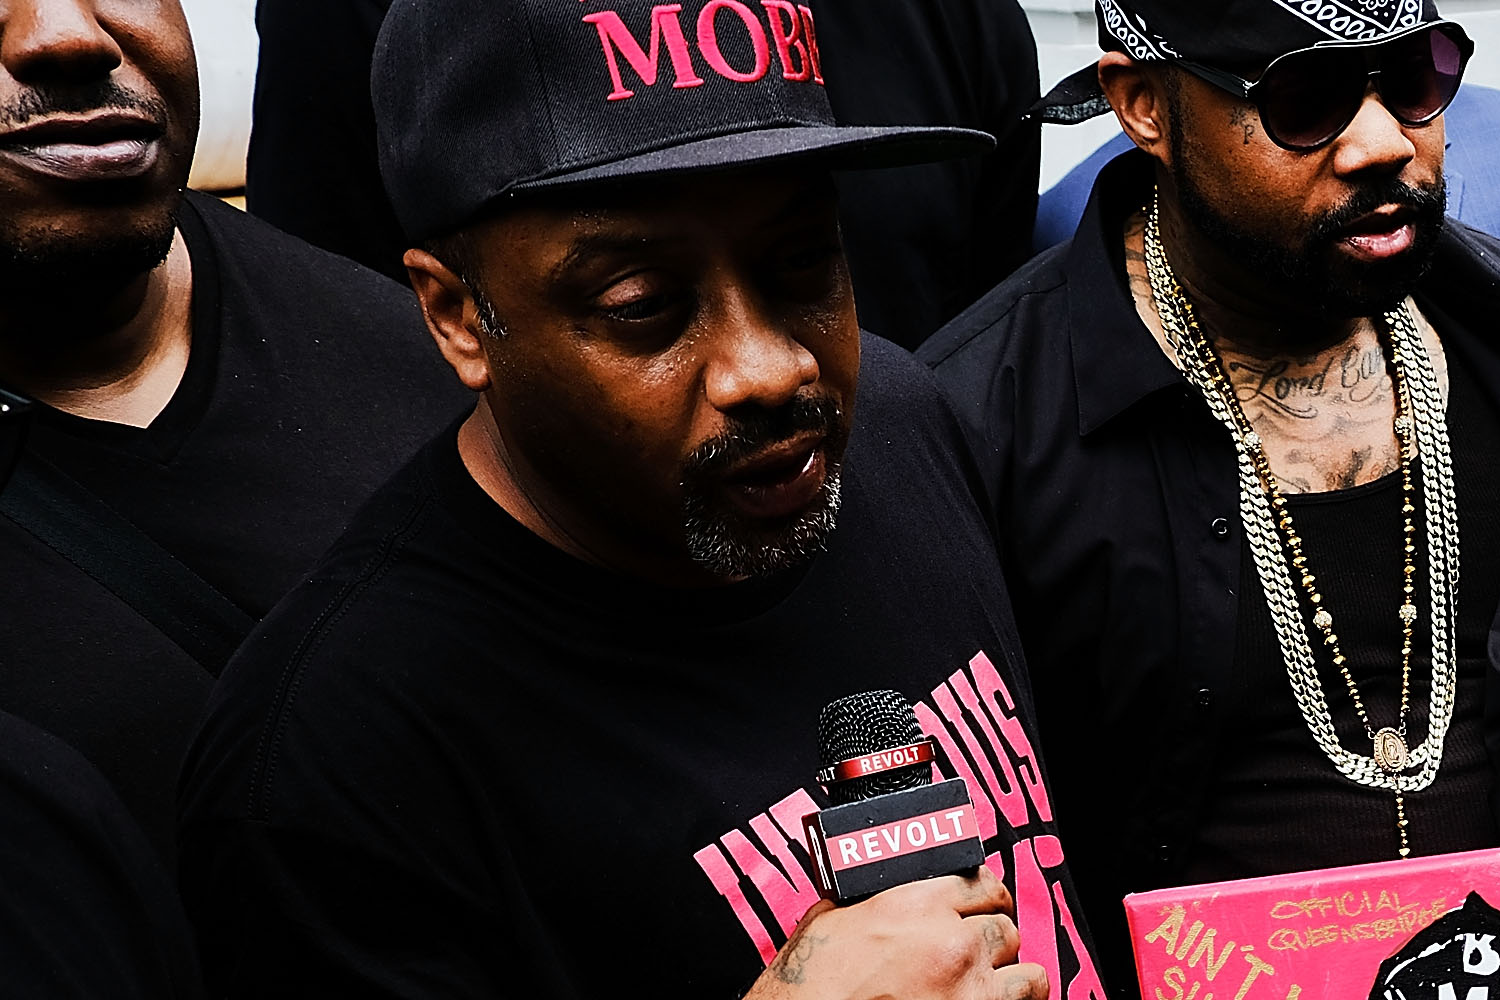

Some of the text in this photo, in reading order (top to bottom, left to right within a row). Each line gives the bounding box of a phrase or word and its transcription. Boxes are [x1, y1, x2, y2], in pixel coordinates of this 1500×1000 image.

[860, 746, 919, 774] REVOLT
[838, 809, 966, 866] REVOLT
[1269, 889, 1420, 920] OFFICIAL
